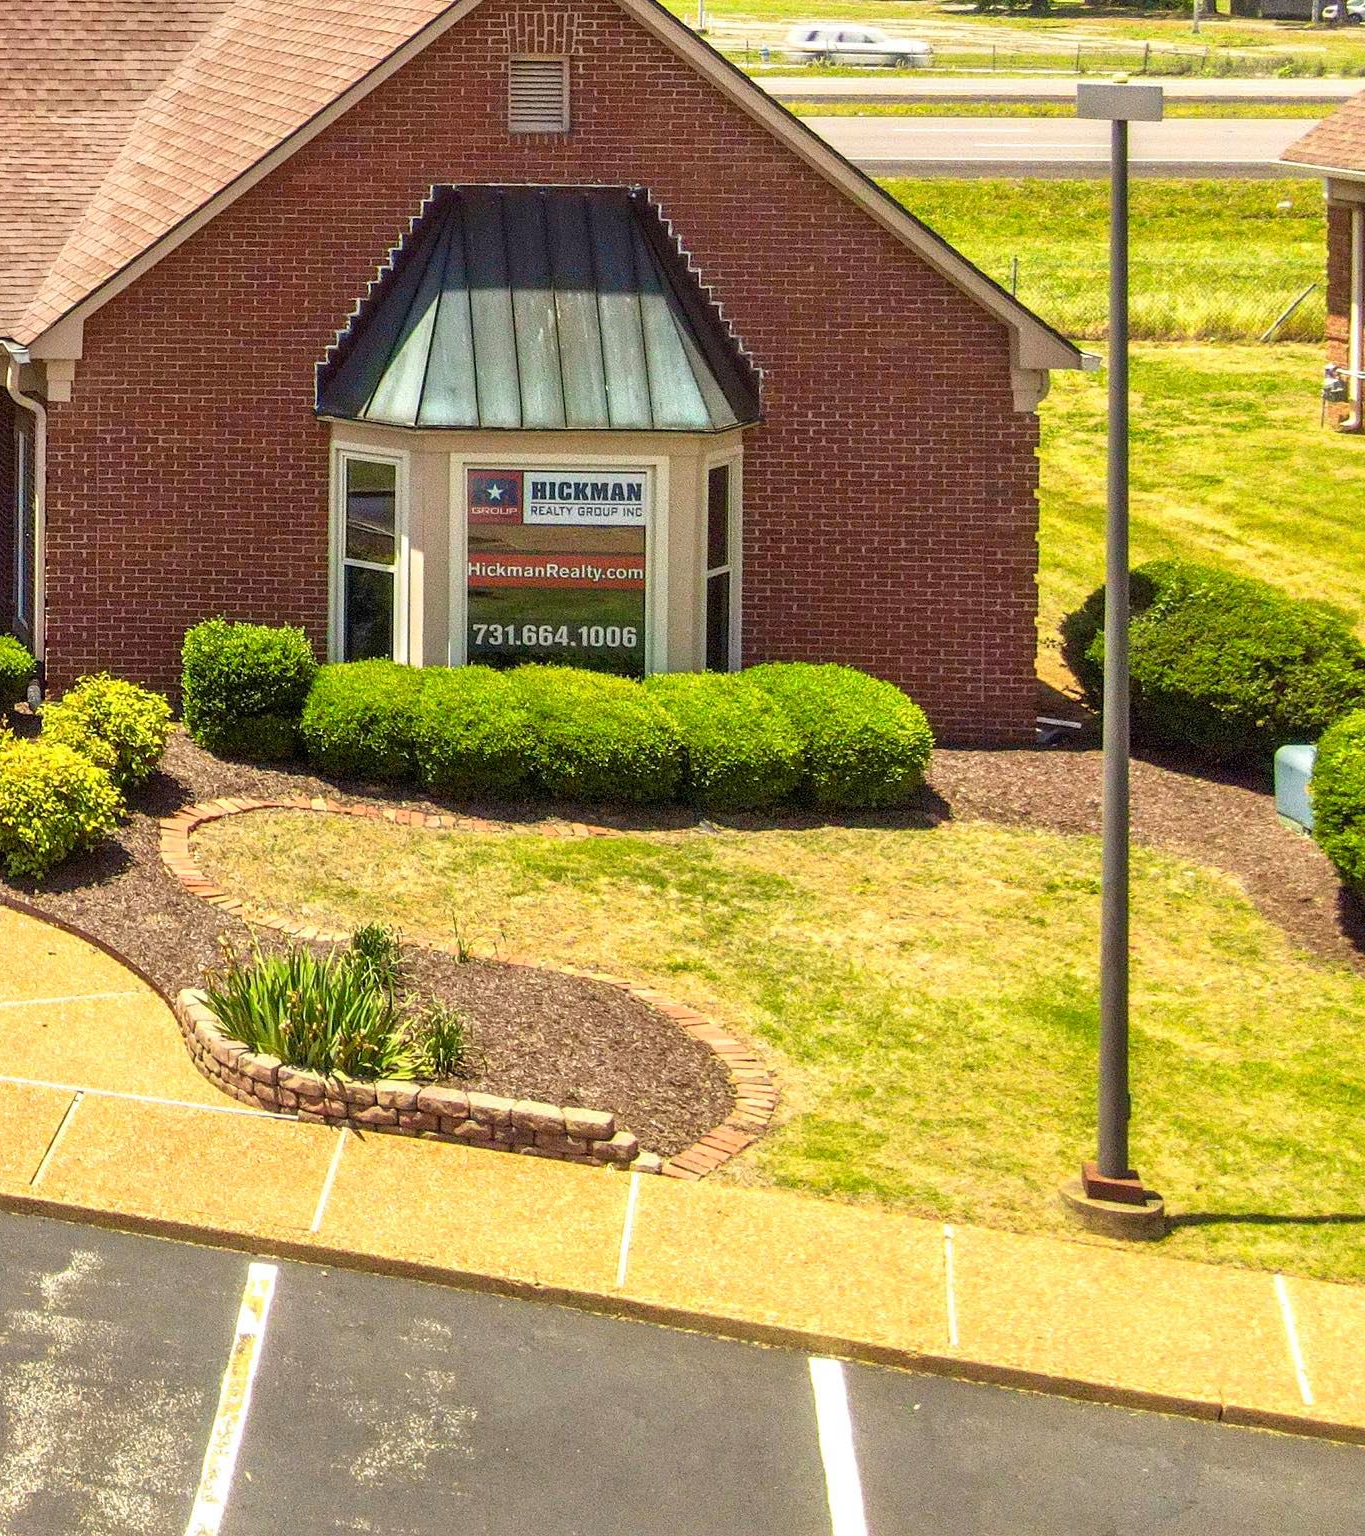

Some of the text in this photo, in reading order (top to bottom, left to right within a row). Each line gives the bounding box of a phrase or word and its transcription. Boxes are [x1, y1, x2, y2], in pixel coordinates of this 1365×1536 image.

[531, 481, 642, 502] HICKMAN
[471, 506, 518, 515] GROUP
[530, 505, 643, 517] REALTY GROUP INC
[468, 562, 644, 582] HickmanRealty.com
[472, 623, 638, 648] 731.664.1006
